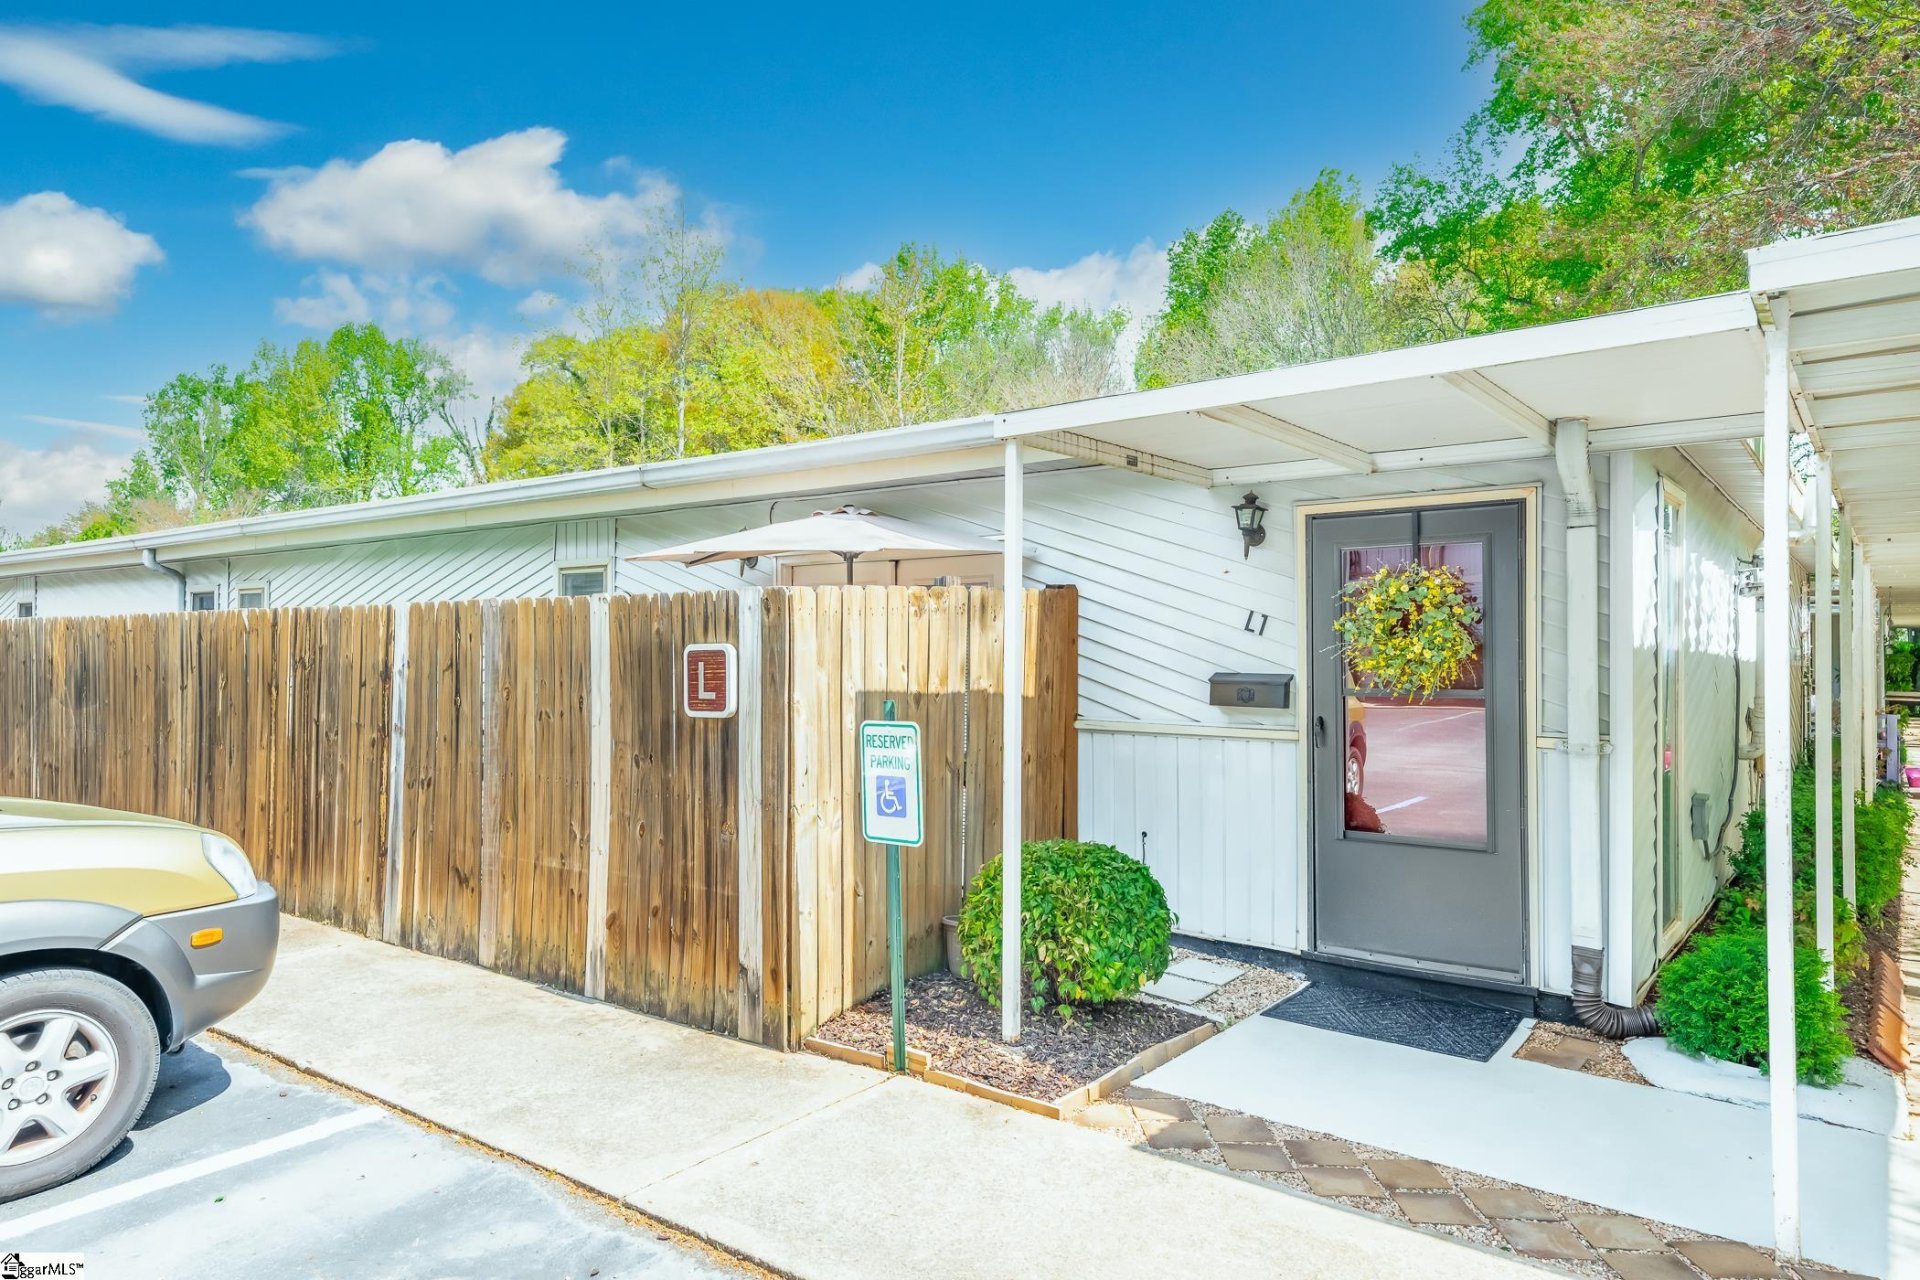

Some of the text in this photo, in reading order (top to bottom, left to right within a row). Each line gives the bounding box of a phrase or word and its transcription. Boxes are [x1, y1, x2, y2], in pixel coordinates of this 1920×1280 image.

[698, 661, 716, 699] L
[866, 734, 913, 749] RESERVED
[870, 754, 911, 771] PARKING
